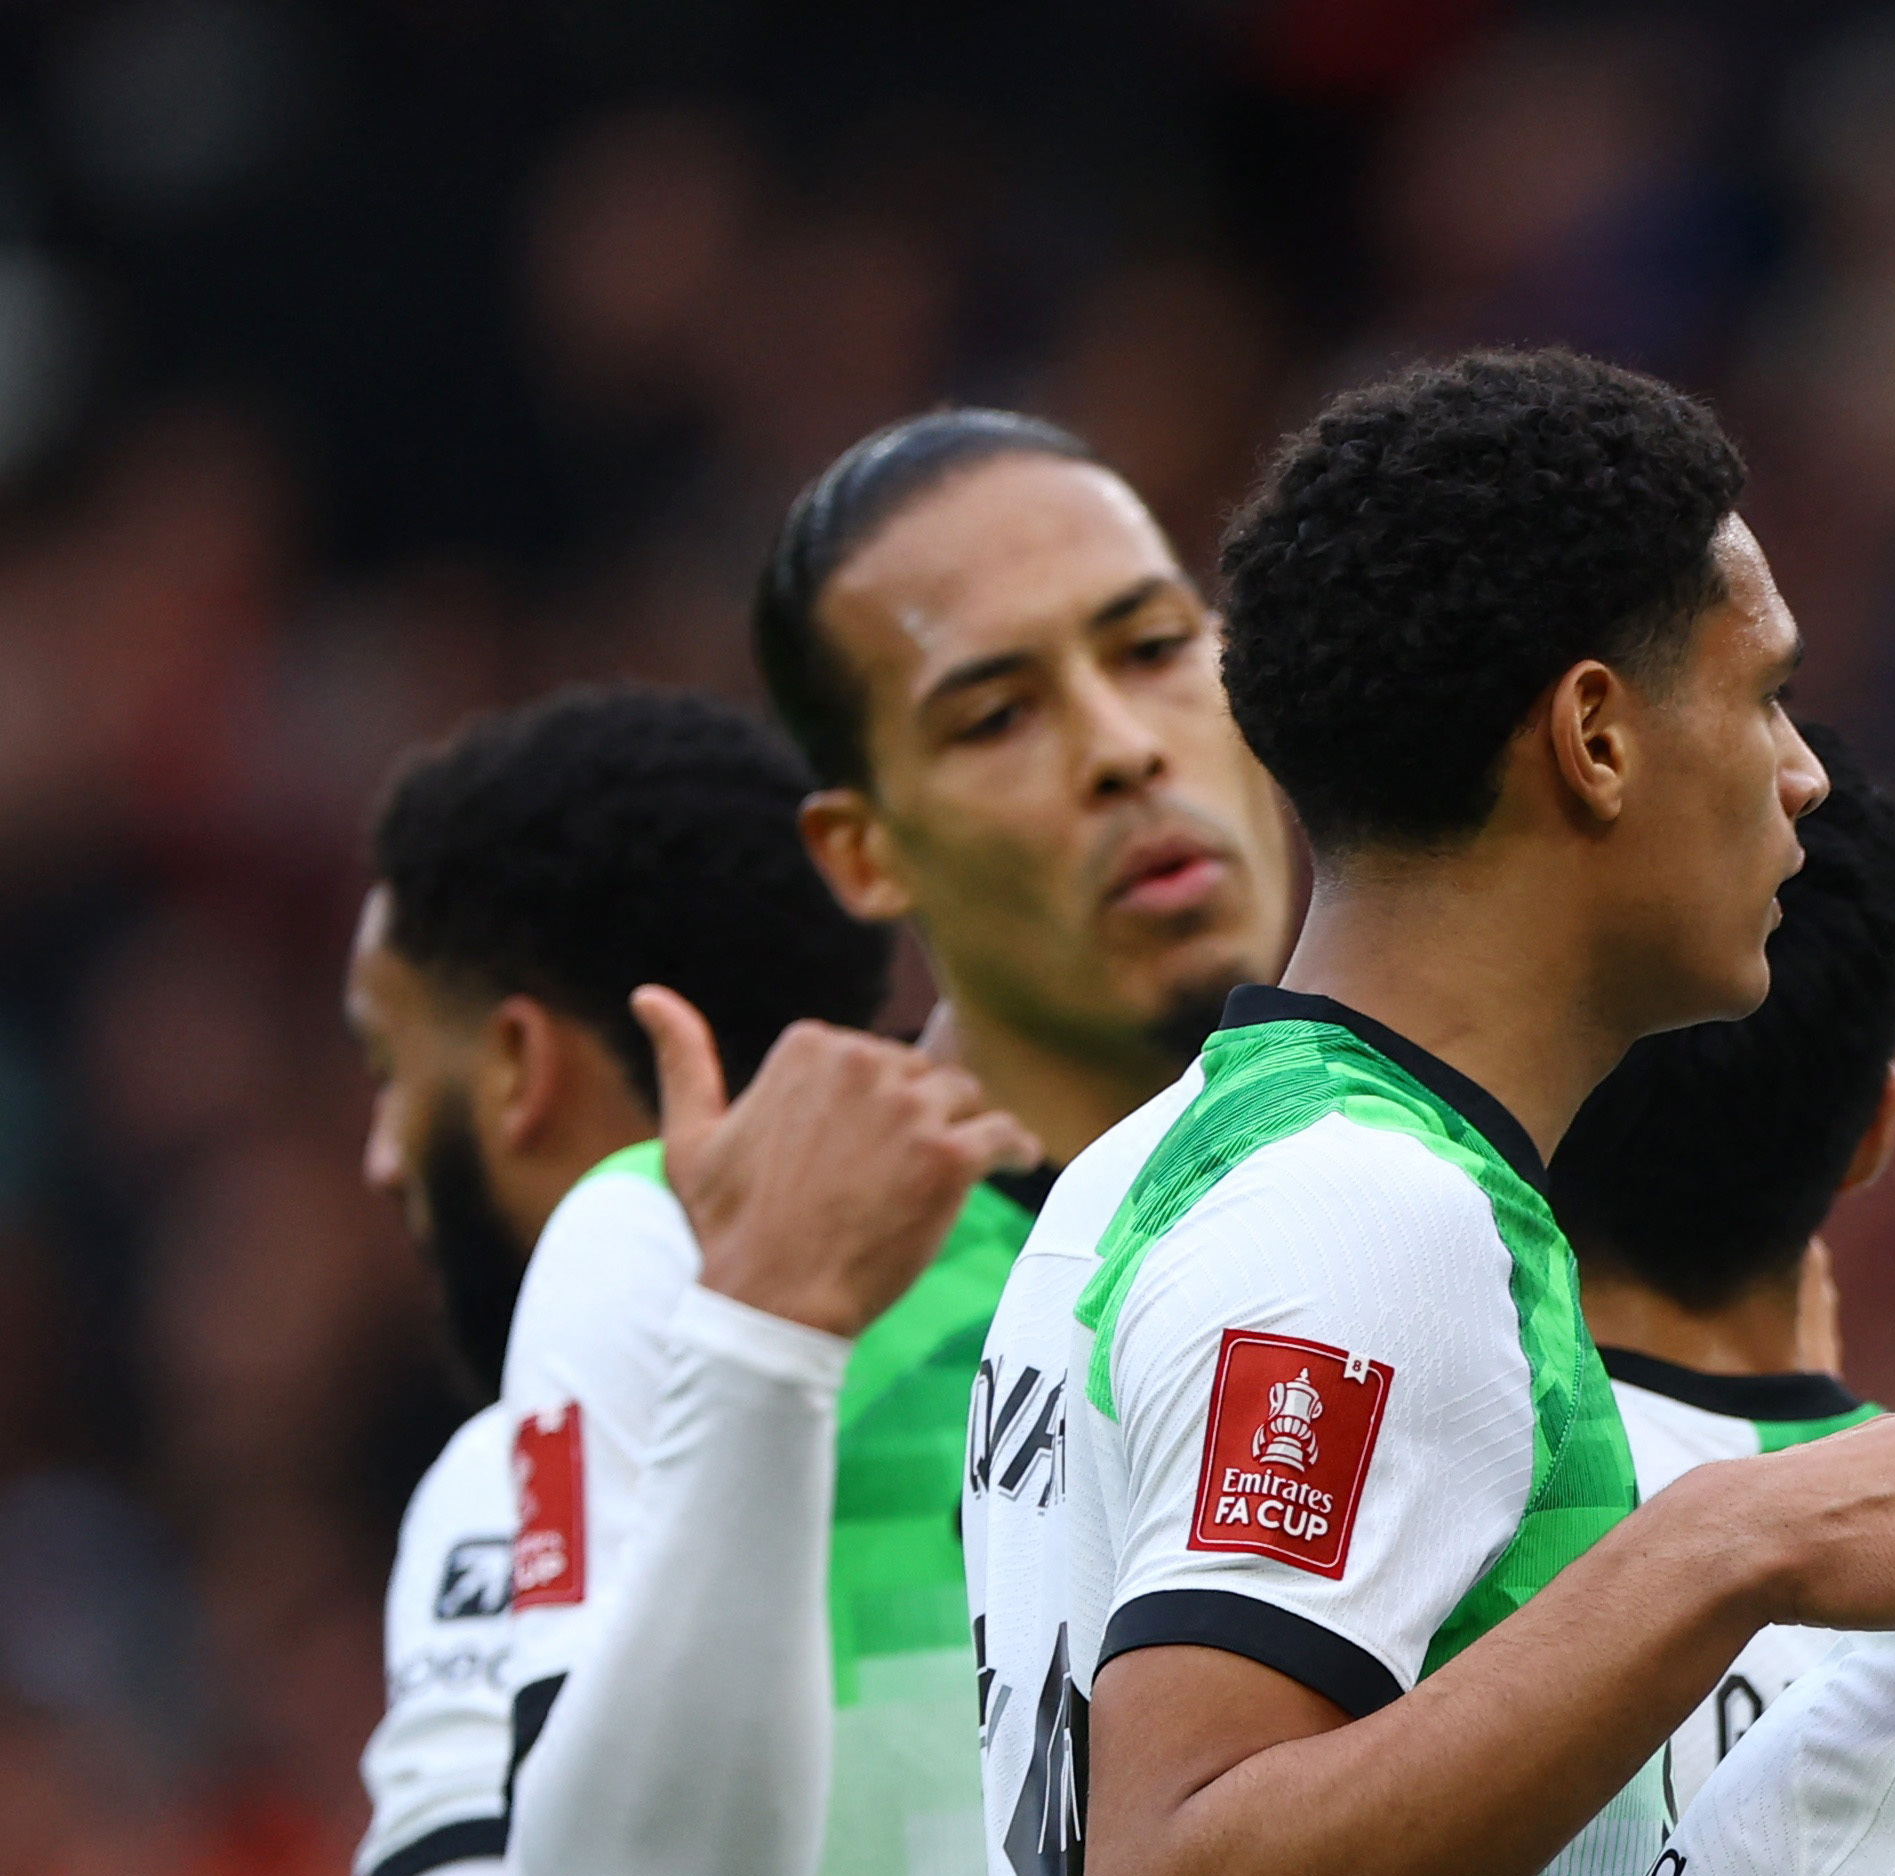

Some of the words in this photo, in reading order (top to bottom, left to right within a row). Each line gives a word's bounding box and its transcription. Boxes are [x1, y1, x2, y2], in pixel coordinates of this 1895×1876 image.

[1351, 1359, 1363, 1373] 8
[1222, 1467, 1334, 1513] Emirates
[1214, 1495, 1249, 1525] FA
[1256, 1499, 1329, 1541] CUP
